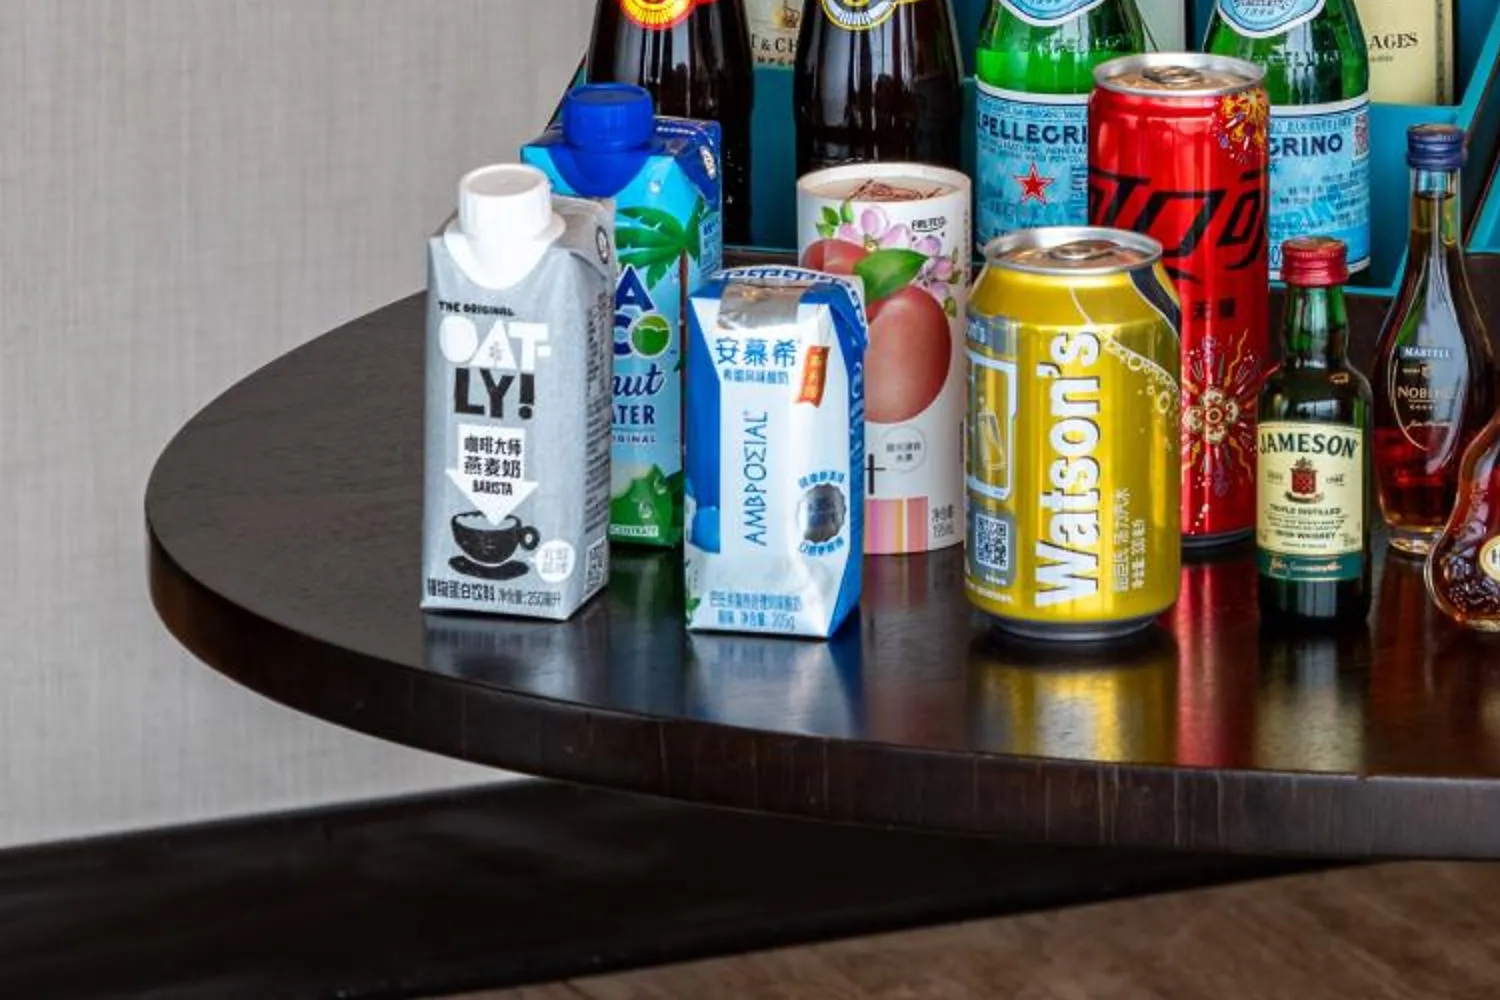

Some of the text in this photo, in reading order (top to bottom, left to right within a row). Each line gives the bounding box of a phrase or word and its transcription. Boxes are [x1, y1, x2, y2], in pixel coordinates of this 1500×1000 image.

[439, 315, 552, 372] OAT-
[715, 336, 797, 368] 安慕希
[454, 367, 535, 420] LY!
[464, 434, 522, 456] 咖啡大师
[1260, 432, 1357, 459] JAMESON
[464, 456, 522, 479] 燕麦奶
[1035, 330, 1101, 608] Watson's
[472, 479, 513, 495] BARISTA
